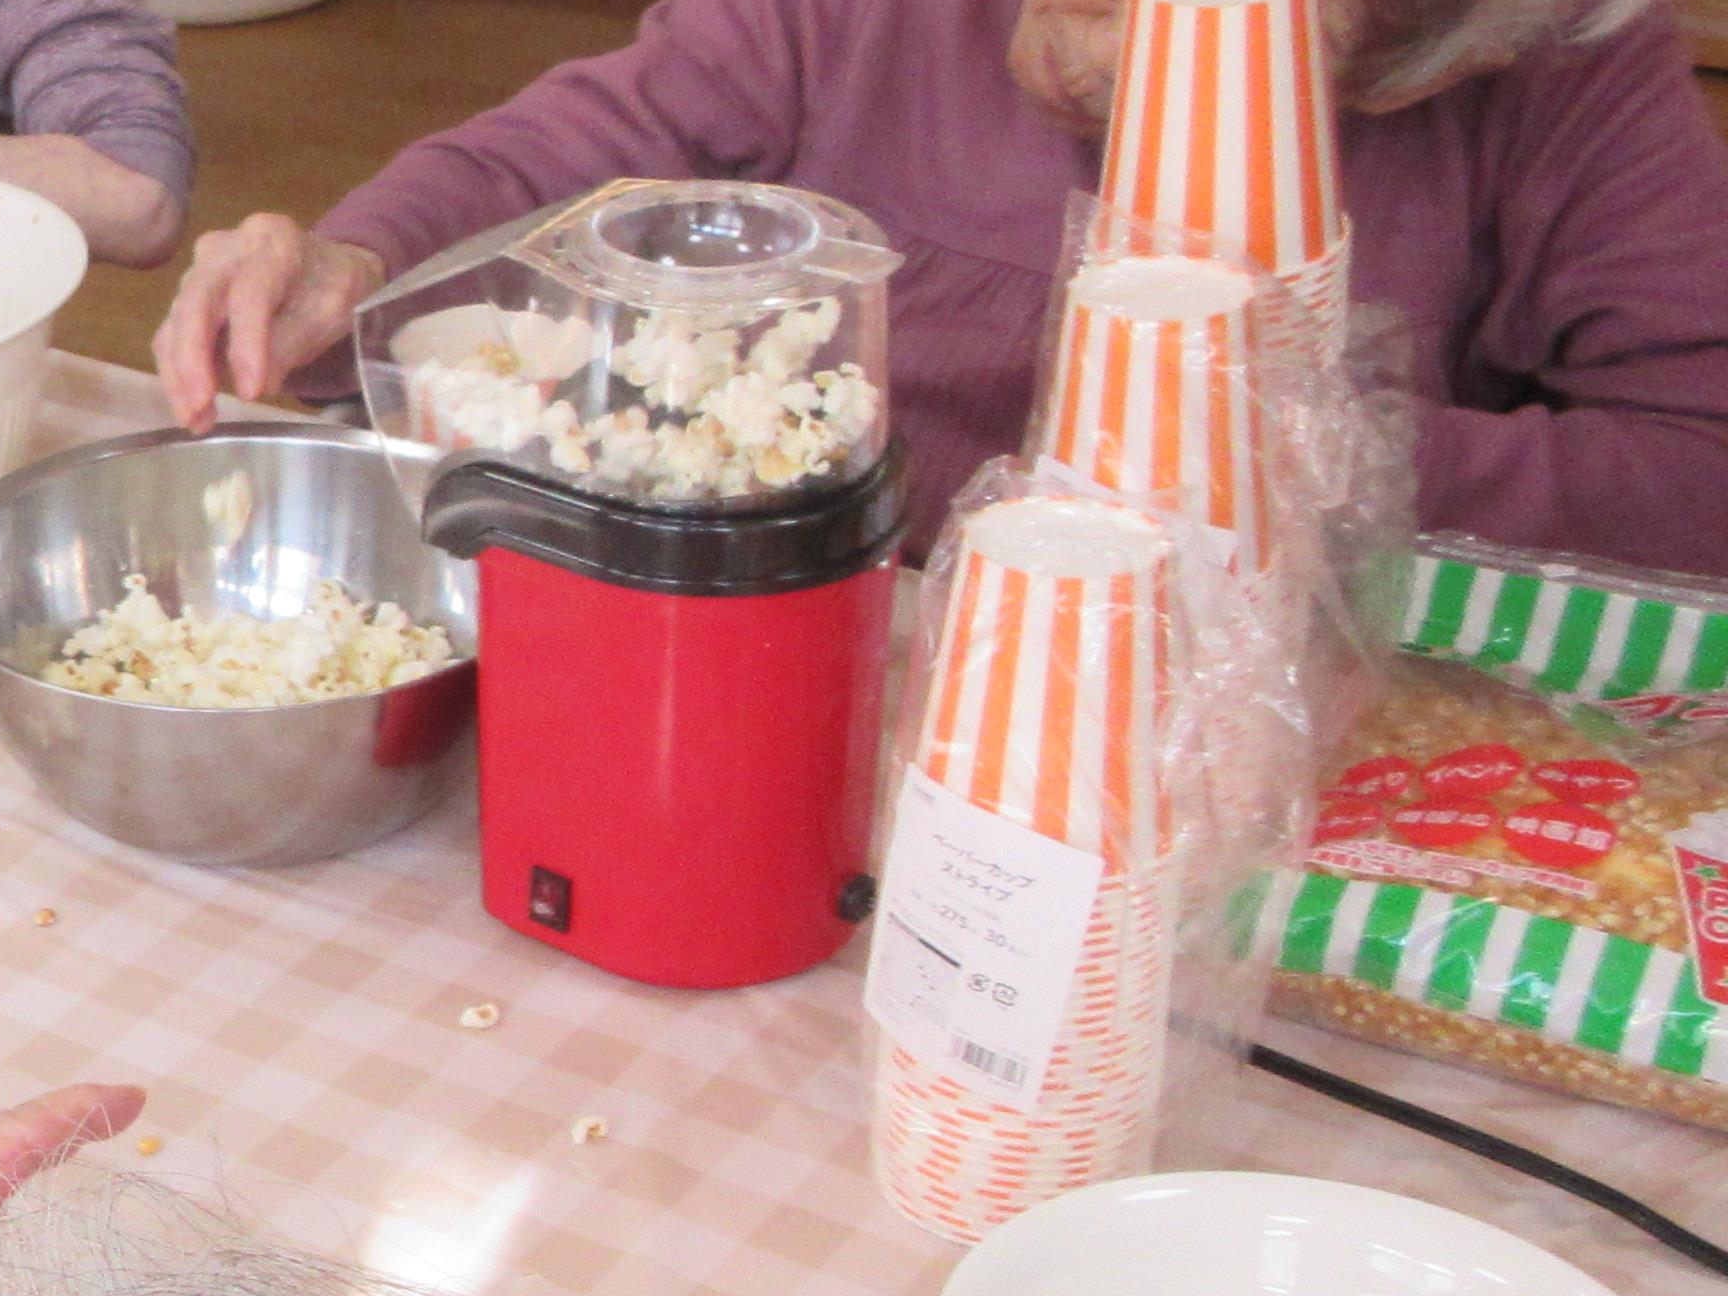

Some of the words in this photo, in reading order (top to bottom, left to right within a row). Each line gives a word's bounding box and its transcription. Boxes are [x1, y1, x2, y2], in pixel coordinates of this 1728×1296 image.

[940, 862, 1013, 902] ストライプ
